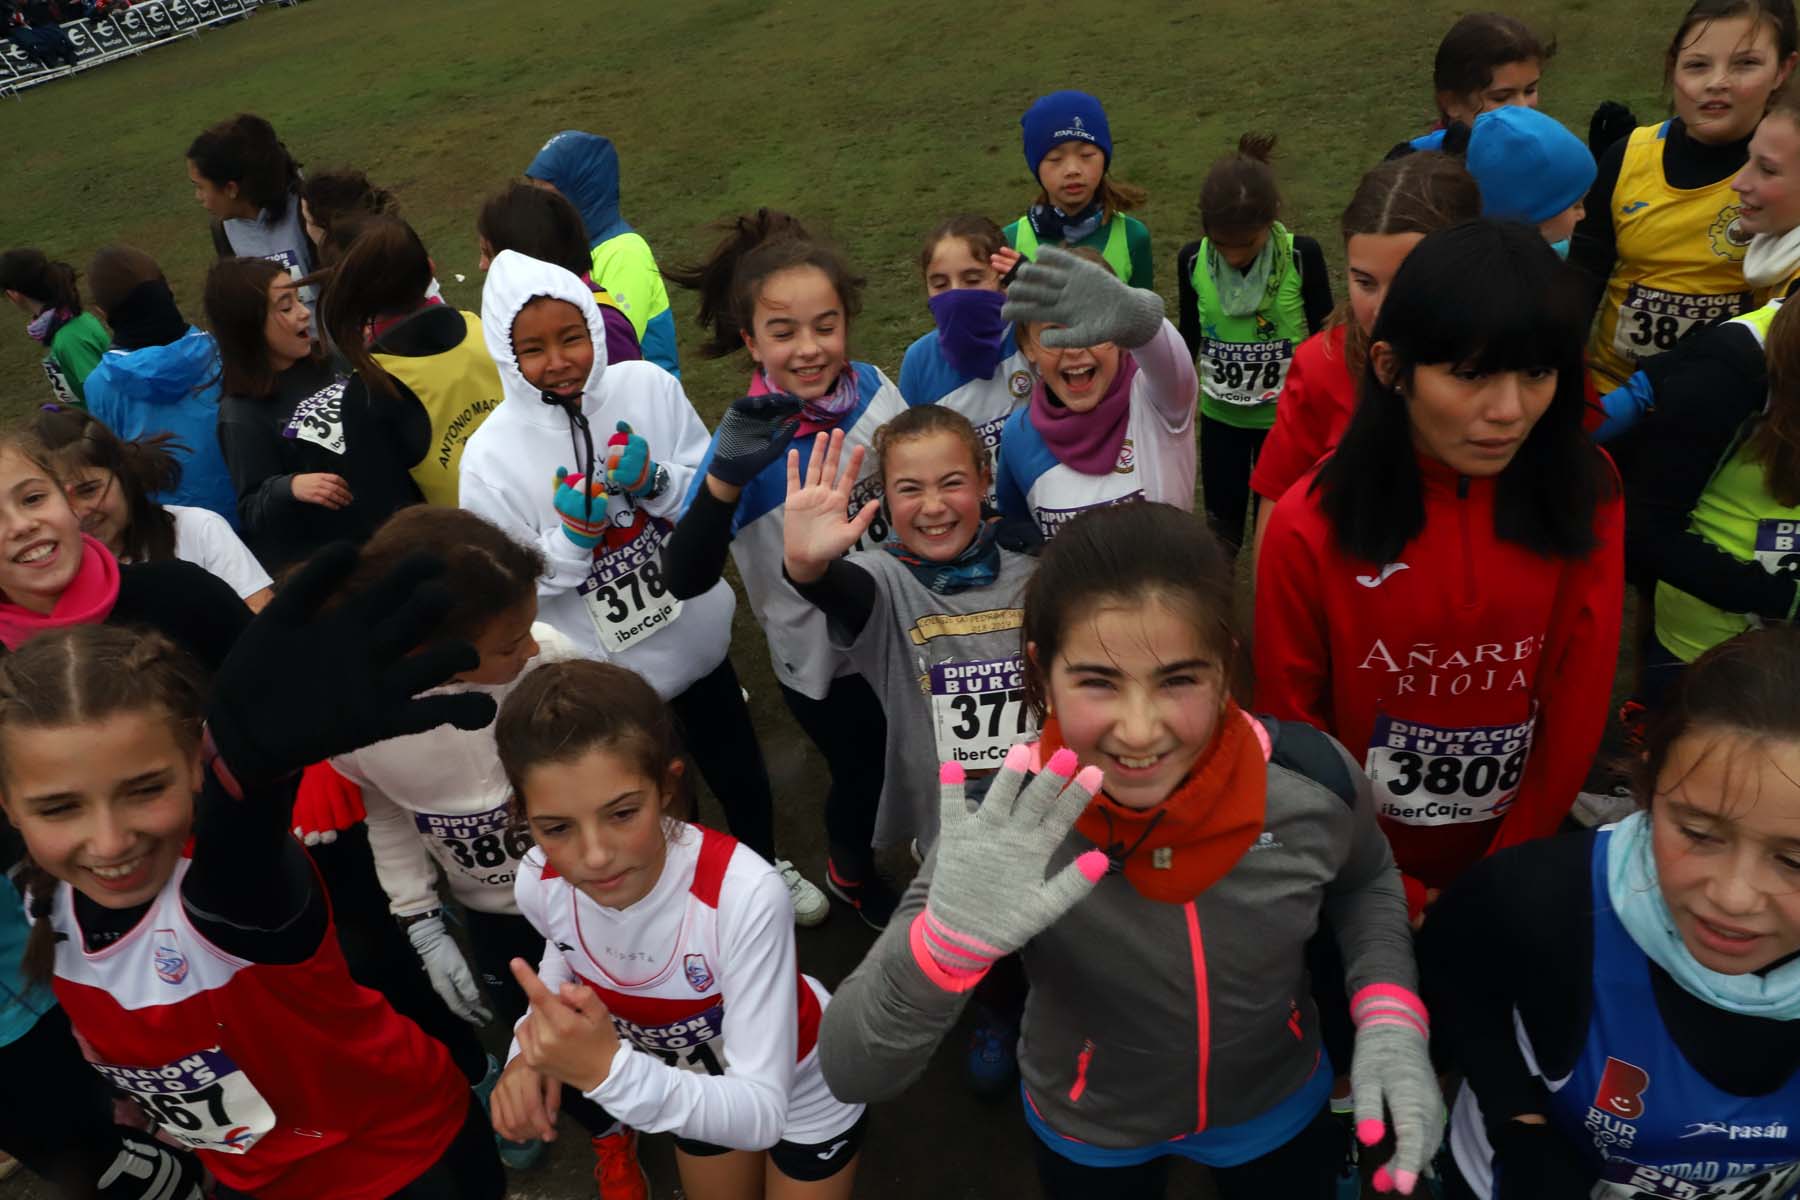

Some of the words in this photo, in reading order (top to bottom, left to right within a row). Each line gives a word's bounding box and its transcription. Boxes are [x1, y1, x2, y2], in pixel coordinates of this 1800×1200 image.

[1211, 358, 1281, 391] 3978
[440, 408, 472, 470] ANTONIO
[586, 529, 662, 590] BURGOS
[591, 520, 656, 573] IPUTACIÓN
[615, 605, 673, 642] iberCaja
[1396, 668, 1528, 697] RIOJA
[1387, 750, 1524, 797] 3808
[1382, 802, 1473, 819] iberCaja
